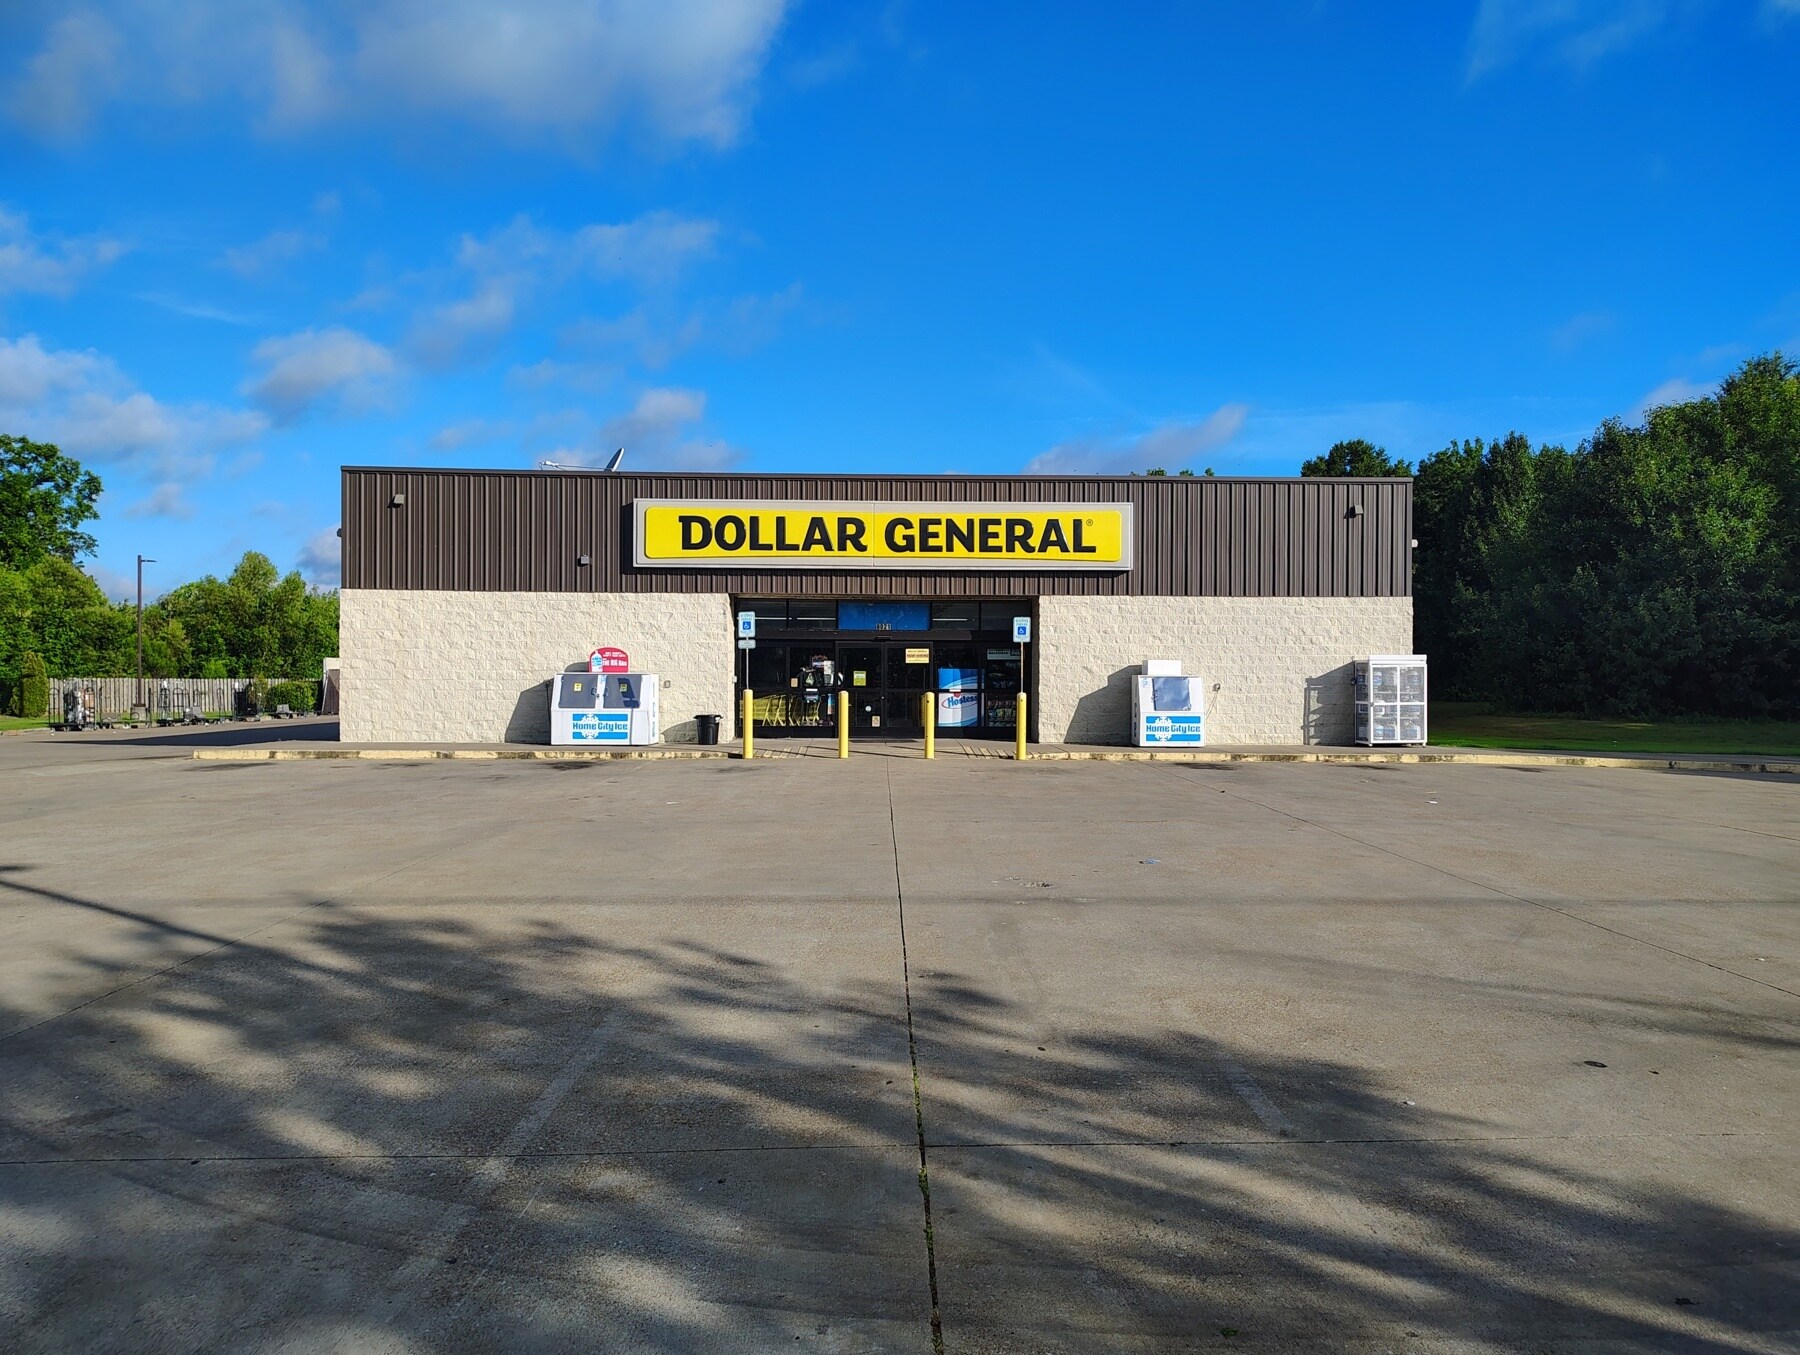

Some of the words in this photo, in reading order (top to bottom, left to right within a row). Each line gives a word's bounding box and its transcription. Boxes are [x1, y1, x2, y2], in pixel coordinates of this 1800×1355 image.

[679, 515, 867, 553] DOLLAR
[885, 517, 1096, 553] GENERAL
[572, 722, 597, 730] Home
[597, 722, 613, 731] City
[614, 722, 628, 730] Ice
[1146, 724, 1170, 732] Home
[1170, 724, 1187, 733] City
[1188, 724, 1201, 732] Ice
